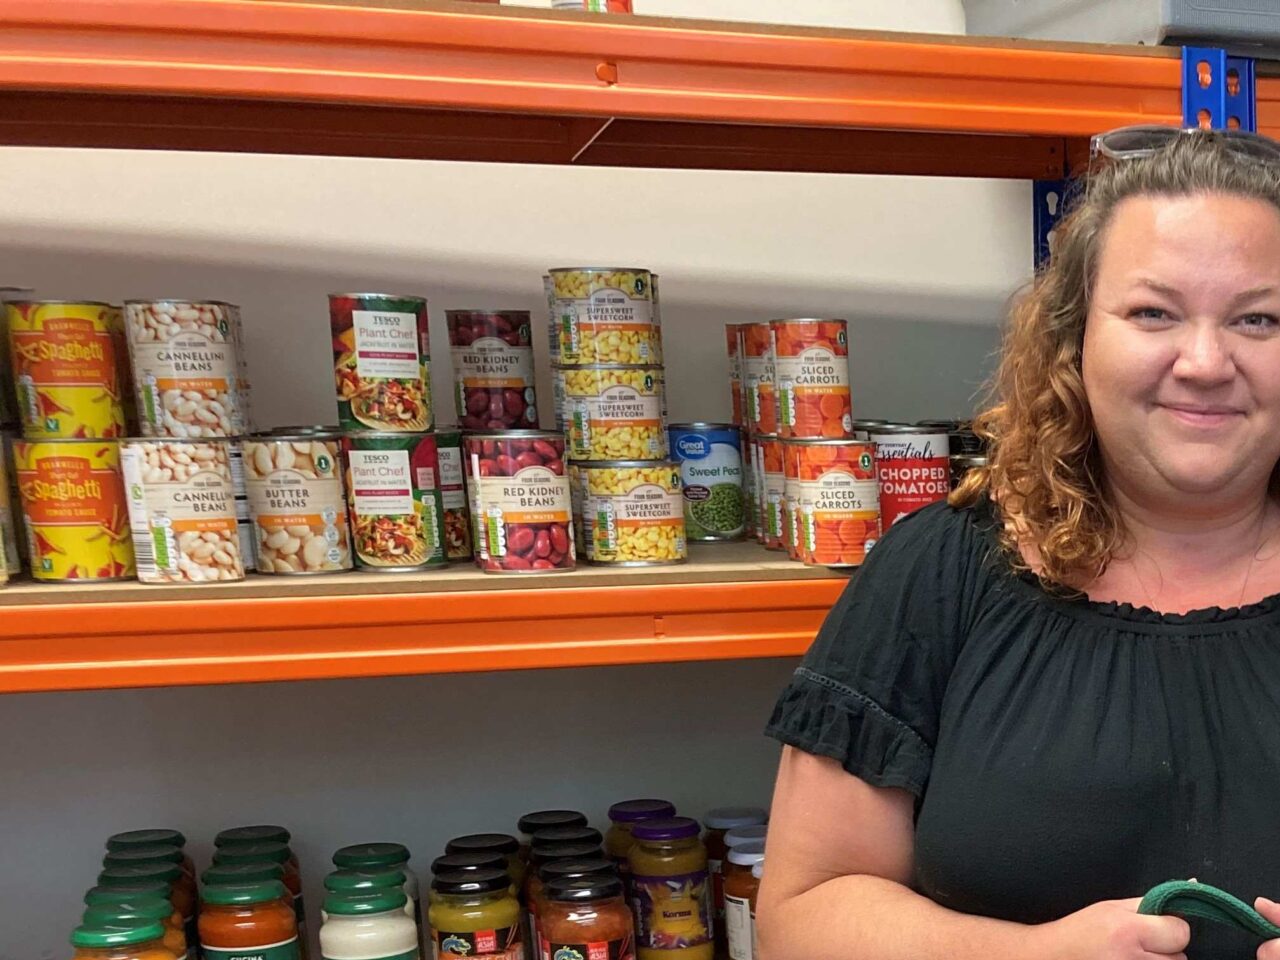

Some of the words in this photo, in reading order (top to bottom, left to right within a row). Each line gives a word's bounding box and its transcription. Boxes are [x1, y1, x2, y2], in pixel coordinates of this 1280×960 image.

[587, 307, 634, 315] SUPERSWEET
[39, 340, 104, 361] Spaghetti
[157, 351, 224, 361] CANNELLINI
[174, 362, 213, 371] BEANS
[475, 365, 508, 373] BEANS
[801, 366, 834, 375] SLICED
[795, 375, 840, 384] CARROTS
[679, 440, 704, 450] Great
[363, 454, 390, 462] TESCO
[353, 467, 377, 477] Plant
[380, 467, 404, 477] Chef
[689, 466, 720, 477] Sweet
[880, 467, 945, 480] CHOPPED
[33, 478, 103, 500] Spaghetti
[503, 487, 525, 496] RED
[529, 487, 564, 496] KIDNEY
[878, 481, 948, 494] TOMATOES
[265, 488, 310, 498] BUTTER
[820, 491, 855, 499] SLICED
[270, 499, 307, 508] BEANS
[520, 497, 555, 506] BEANS
[815, 500, 862, 509] CARROTS
[193, 502, 227, 512] BEANS
[662, 910, 692, 918] Korma
